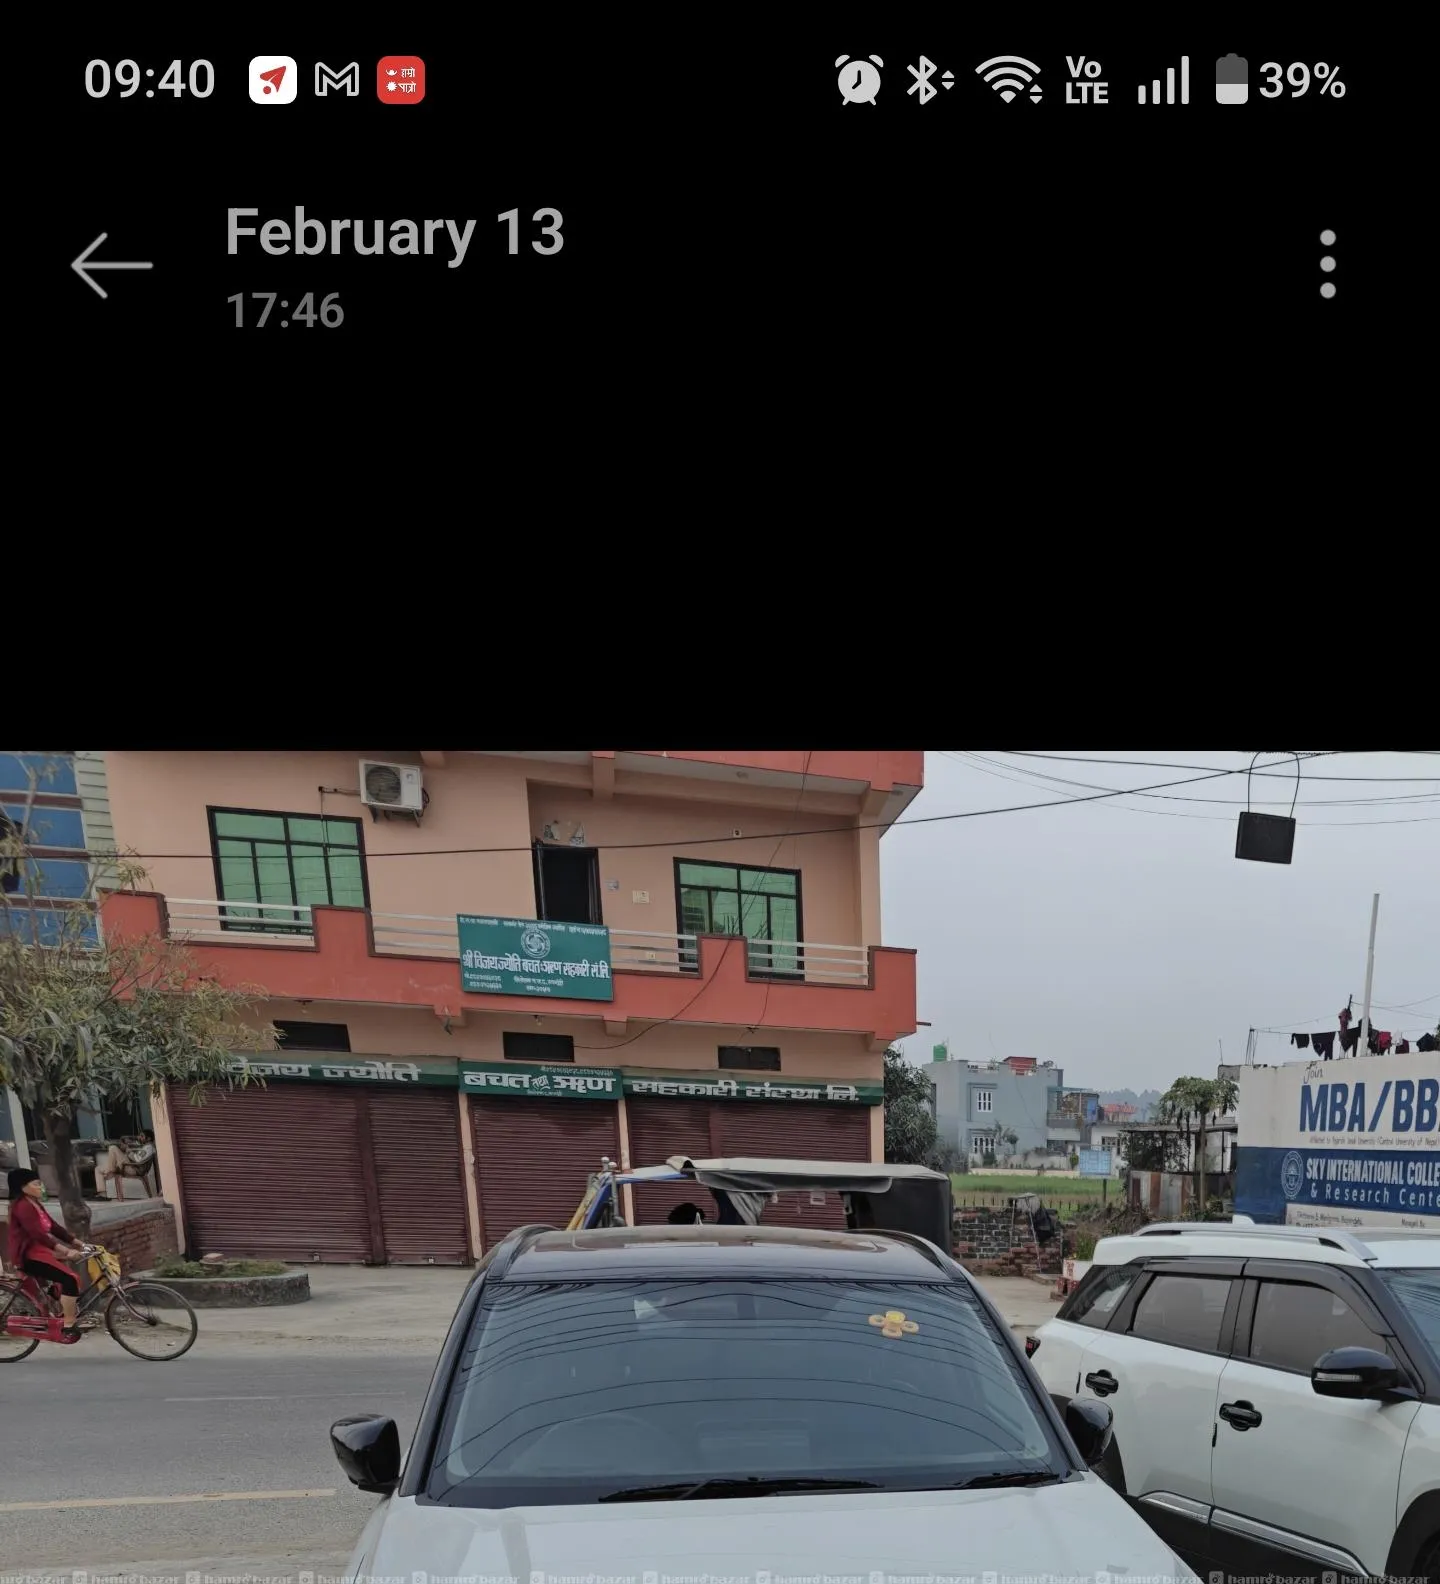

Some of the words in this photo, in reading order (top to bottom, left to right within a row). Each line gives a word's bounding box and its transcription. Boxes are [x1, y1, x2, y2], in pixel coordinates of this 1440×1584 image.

[85, 59, 214, 98] 09:40
[1066, 56, 1101, 78] Vo
[1260, 62, 1346, 98] 39%
[1066, 82, 1108, 104] LTE
[228, 206, 476, 268] February
[498, 208, 563, 255] 13
[228, 292, 344, 328] 17:46
[463, 1071, 532, 1088] बचत
[632, 1079, 739, 1097] सहकारी
[746, 1082, 824, 1100] संस्था
[1300, 1079, 1440, 1132] MBA/BB
[1307, 1158, 1326, 1180] SKY
[1327, 1159, 1403, 1184] INTERNATIONAL
[1311, 1182, 1318, 1198] &
[1325, 1184, 1389, 1203] Research
